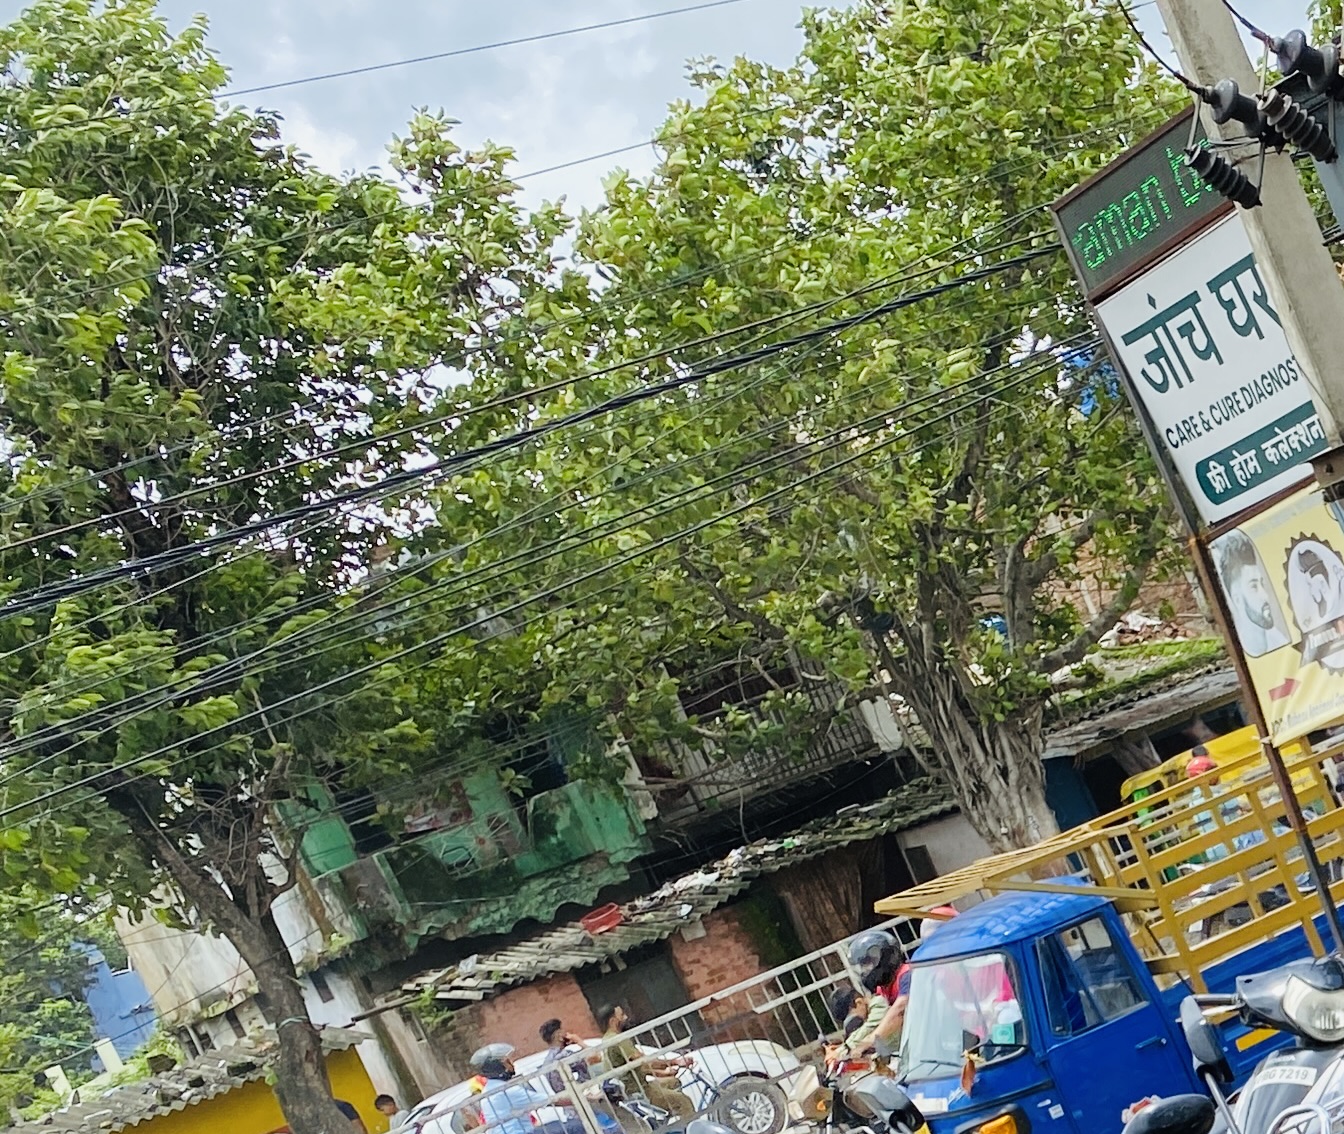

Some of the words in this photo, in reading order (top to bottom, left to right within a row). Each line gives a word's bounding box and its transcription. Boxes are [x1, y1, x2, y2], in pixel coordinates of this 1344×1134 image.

[1121, 292, 1224, 394] जांच
[1206, 252, 1284, 341] घर
[1165, 415, 1202, 449] CARE
[1198, 411, 1214, 432] &
[1209, 391, 1245, 425] CURE
[1206, 460, 1232, 494] फ्री
[1231, 448, 1262, 487] होम
[1260, 413, 1326, 466] कलेक्शन
